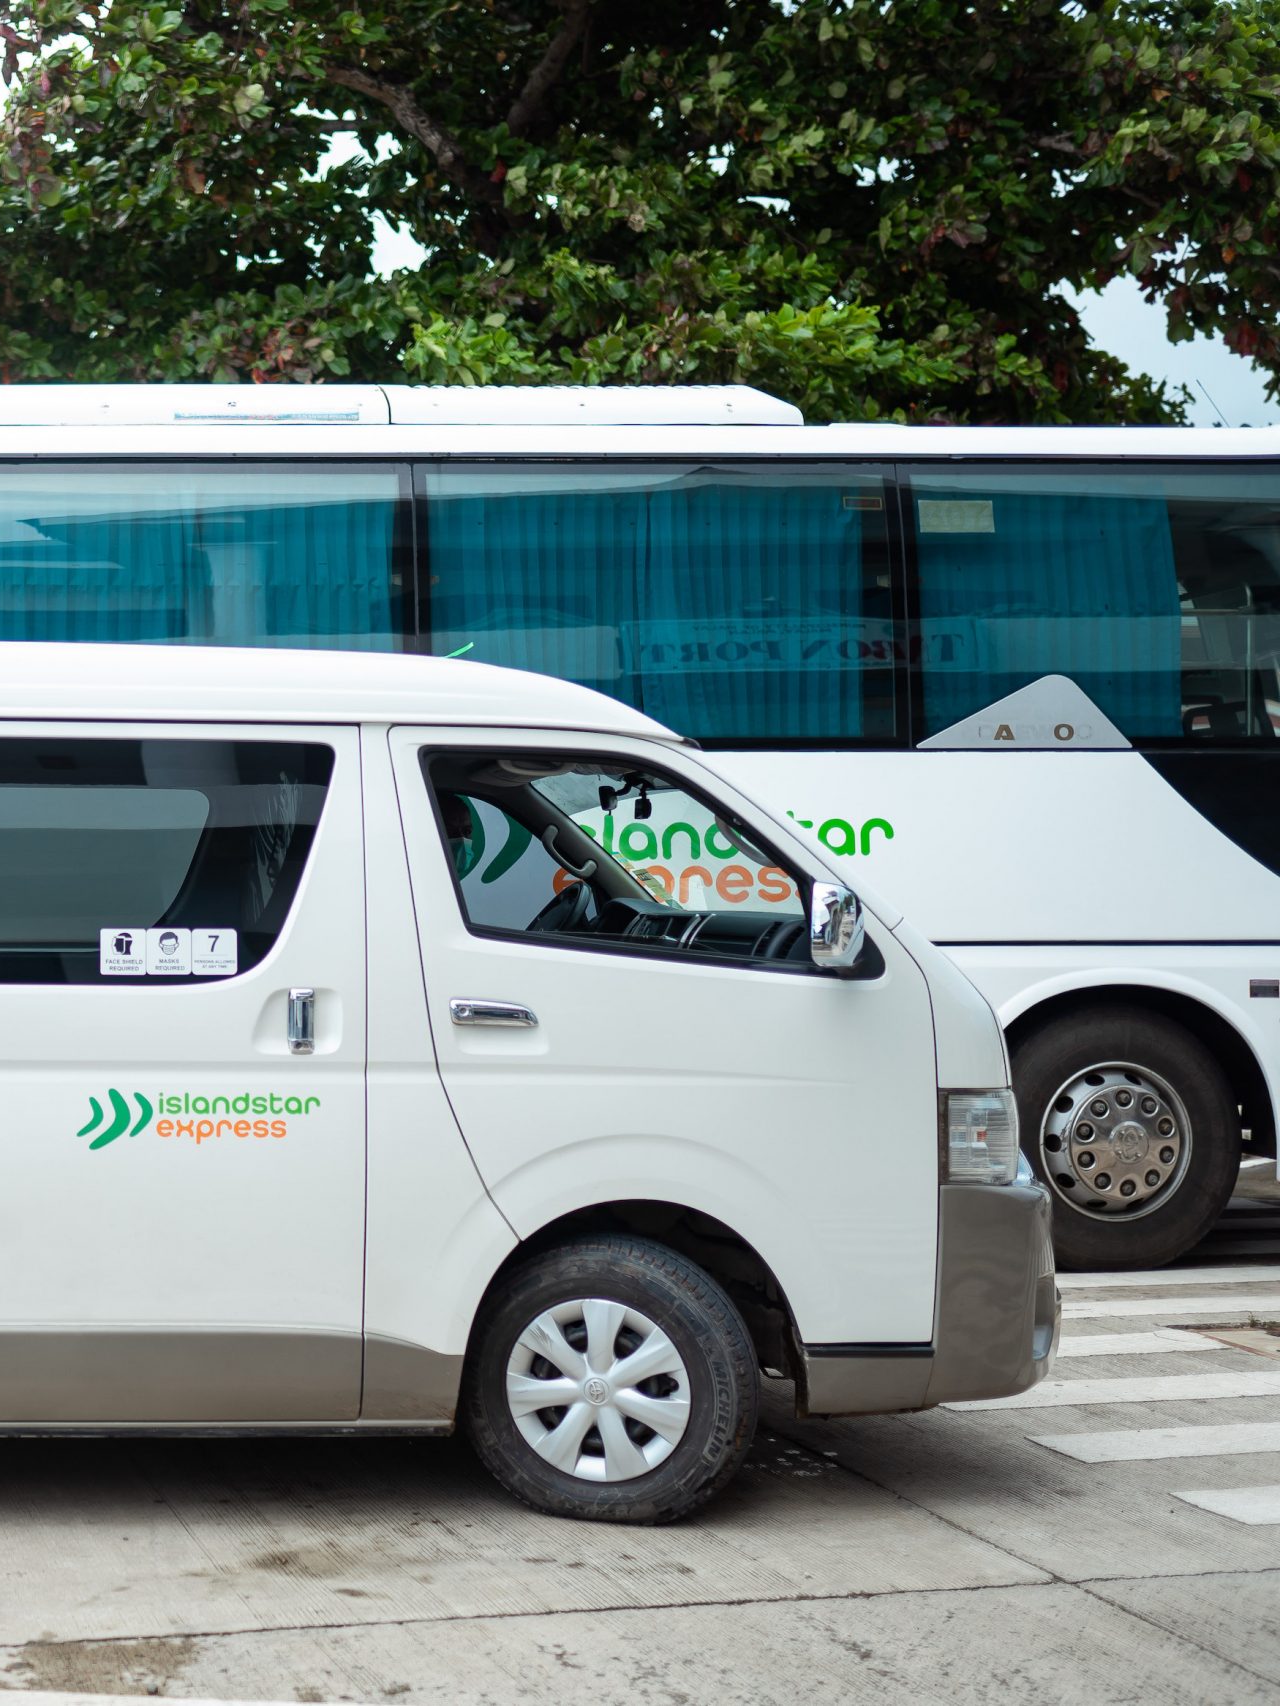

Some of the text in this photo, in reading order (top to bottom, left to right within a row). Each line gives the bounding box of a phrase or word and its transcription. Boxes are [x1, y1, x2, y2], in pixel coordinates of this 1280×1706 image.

[208, 935, 220, 953] 7
[158, 1092, 320, 1114] islandstar
[156, 1119, 287, 1144] express
[708, 1360, 730, 1459] MICHELIN
